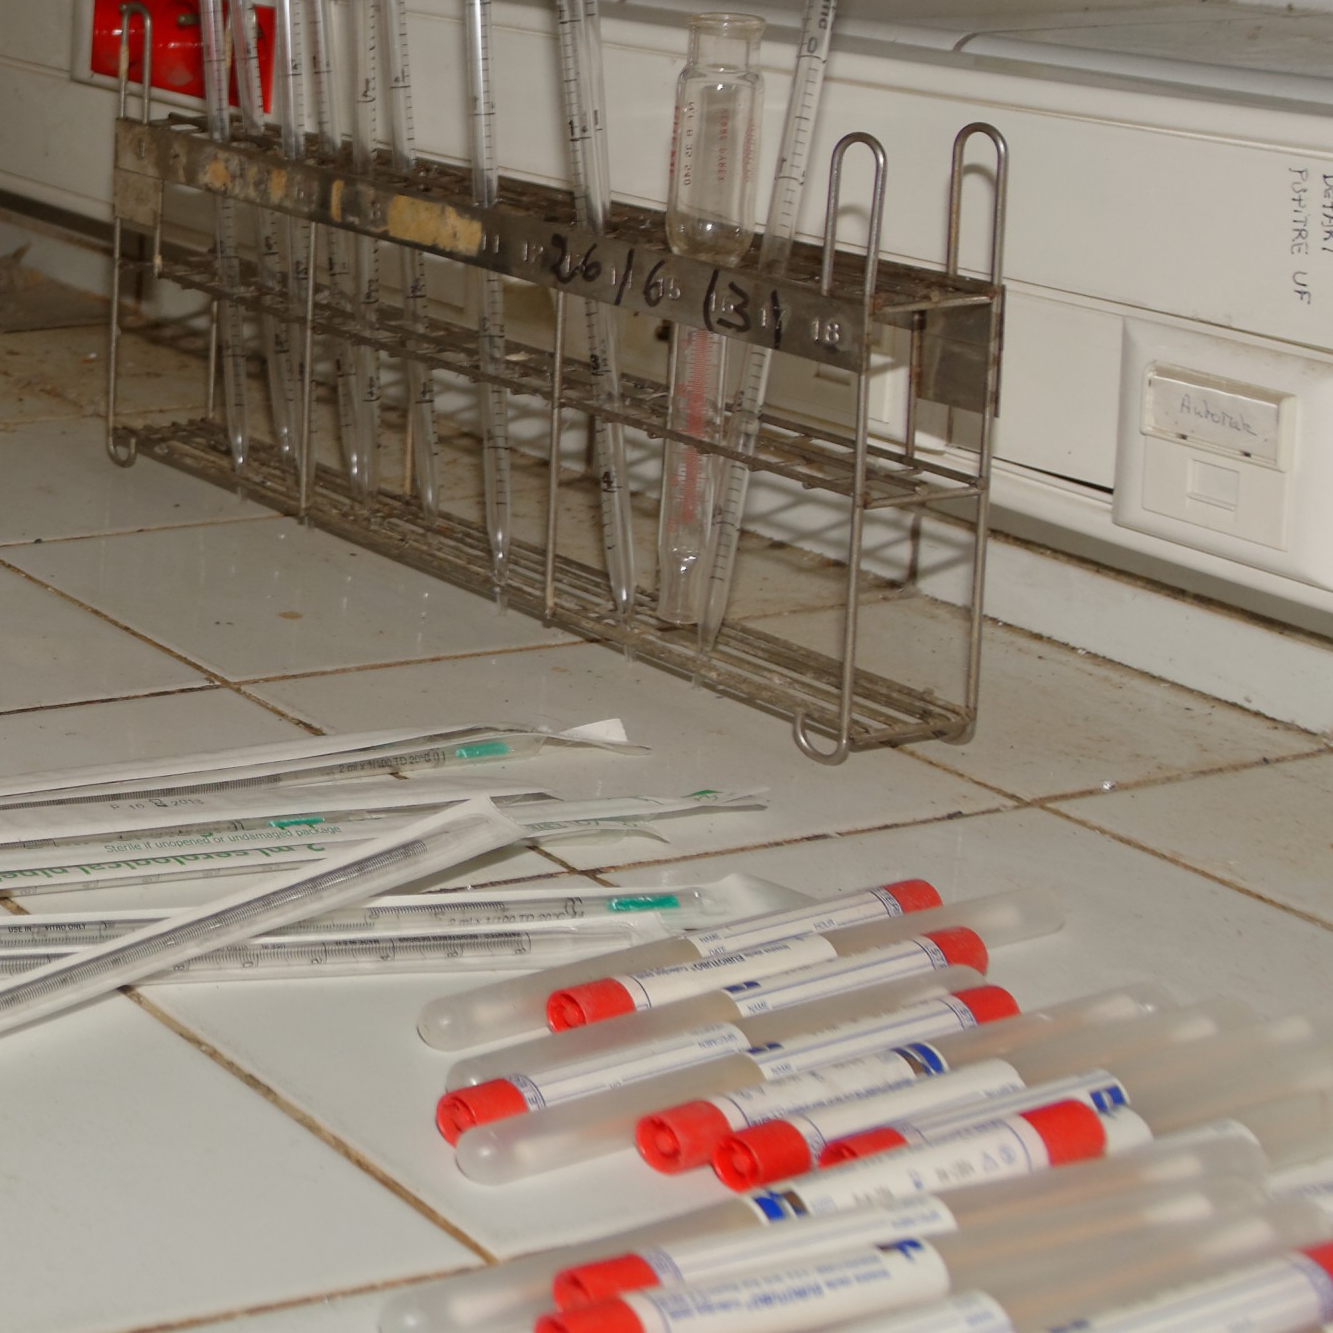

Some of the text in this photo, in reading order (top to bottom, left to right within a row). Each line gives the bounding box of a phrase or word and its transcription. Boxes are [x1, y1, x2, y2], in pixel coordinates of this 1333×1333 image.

[811, 320, 841, 343] 18
[104, 841, 142, 854] Sterile
[154, 835, 211, 850] unopened
[228, 828, 293, 843] undamaged
[296, 824, 342, 838] package
[44, 923, 67, 932] VITRO
[67, 922, 87, 931] ONLY
